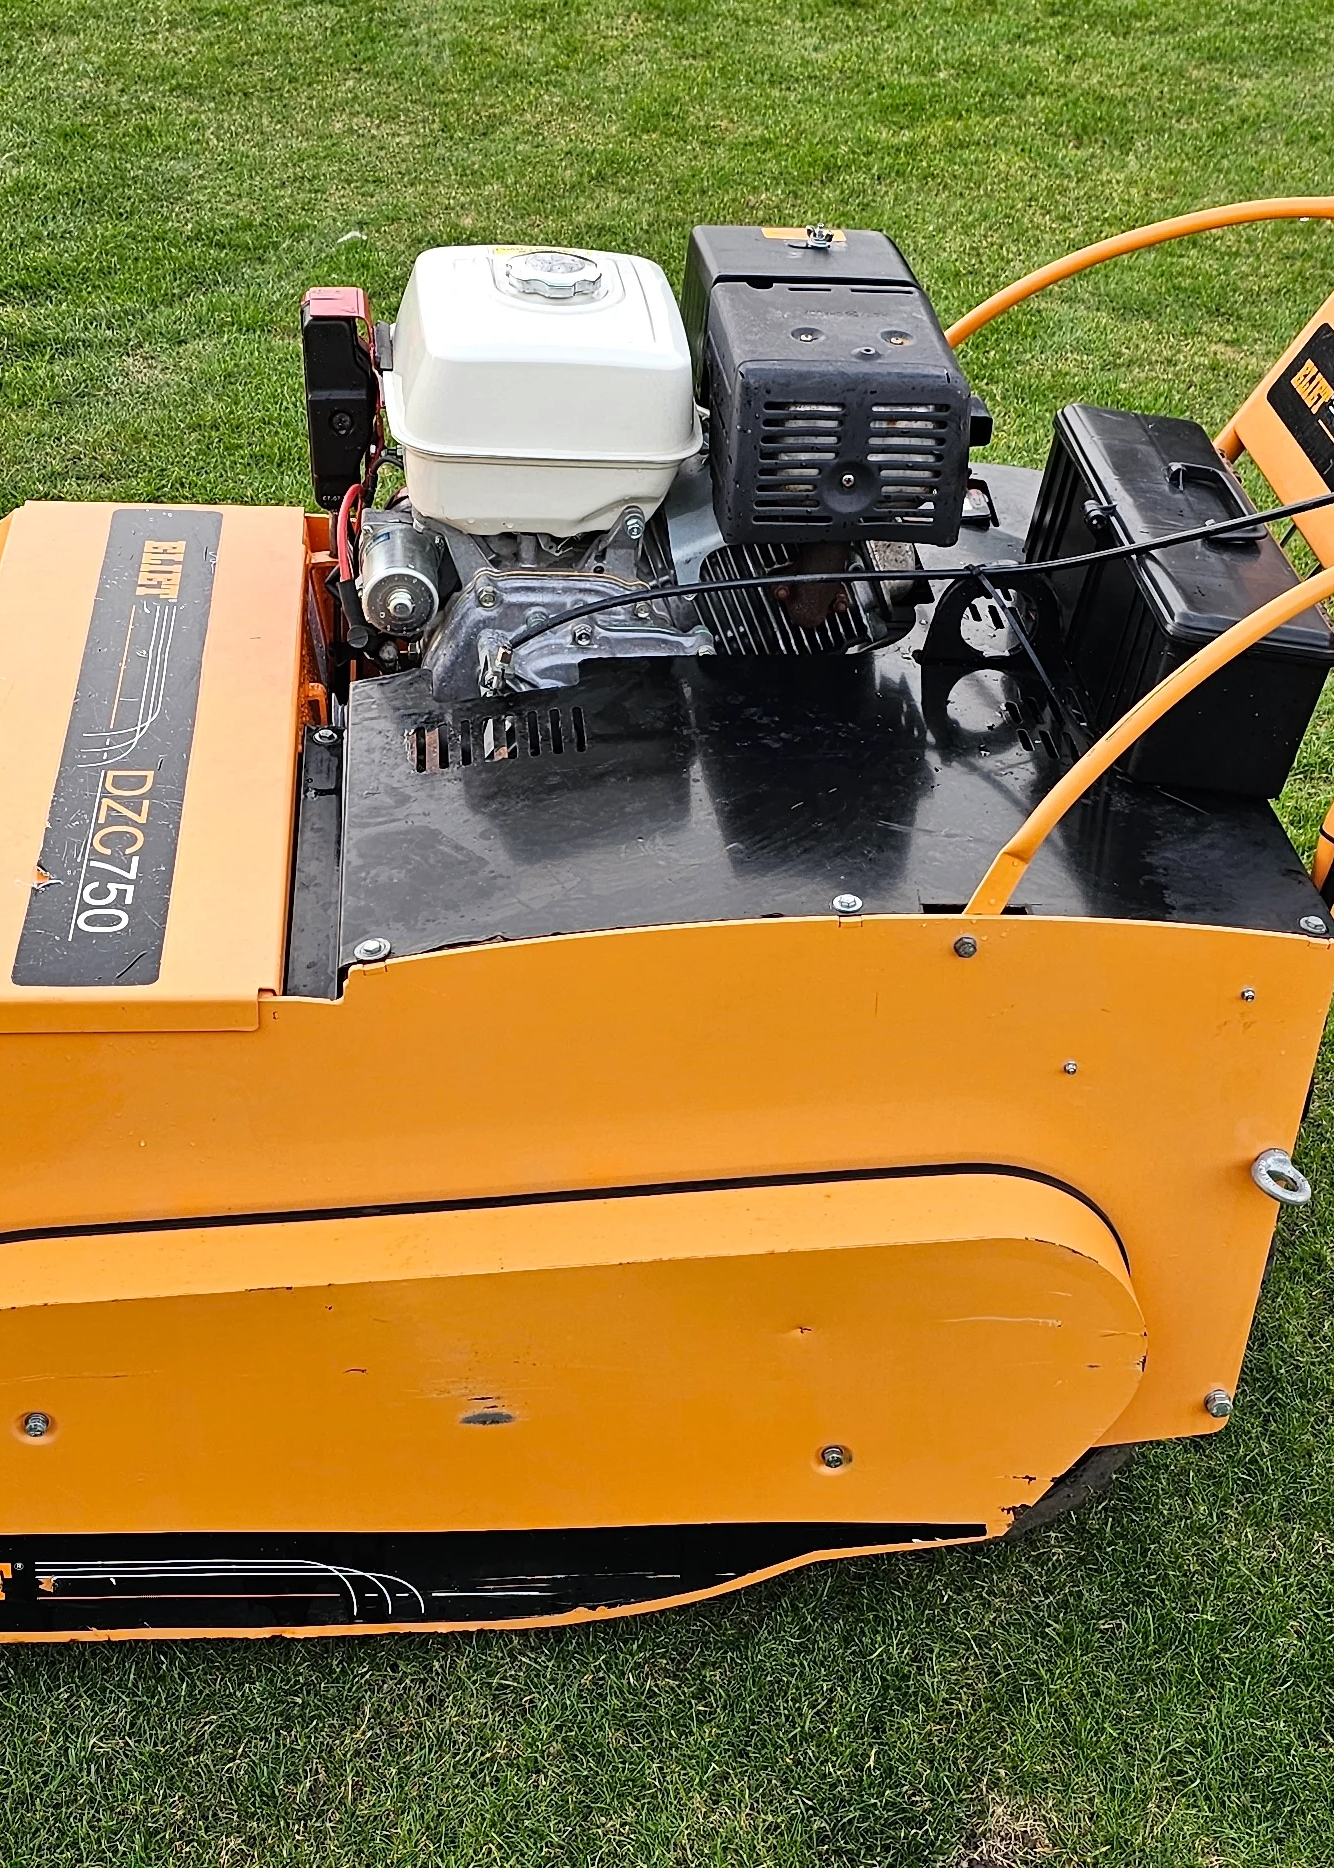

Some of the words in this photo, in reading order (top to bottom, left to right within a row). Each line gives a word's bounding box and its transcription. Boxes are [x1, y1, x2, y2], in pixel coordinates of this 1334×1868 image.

[1289, 357, 1334, 415] ELIET
[135, 540, 186, 599] ELIET
[76, 769, 155, 933] DZC750
